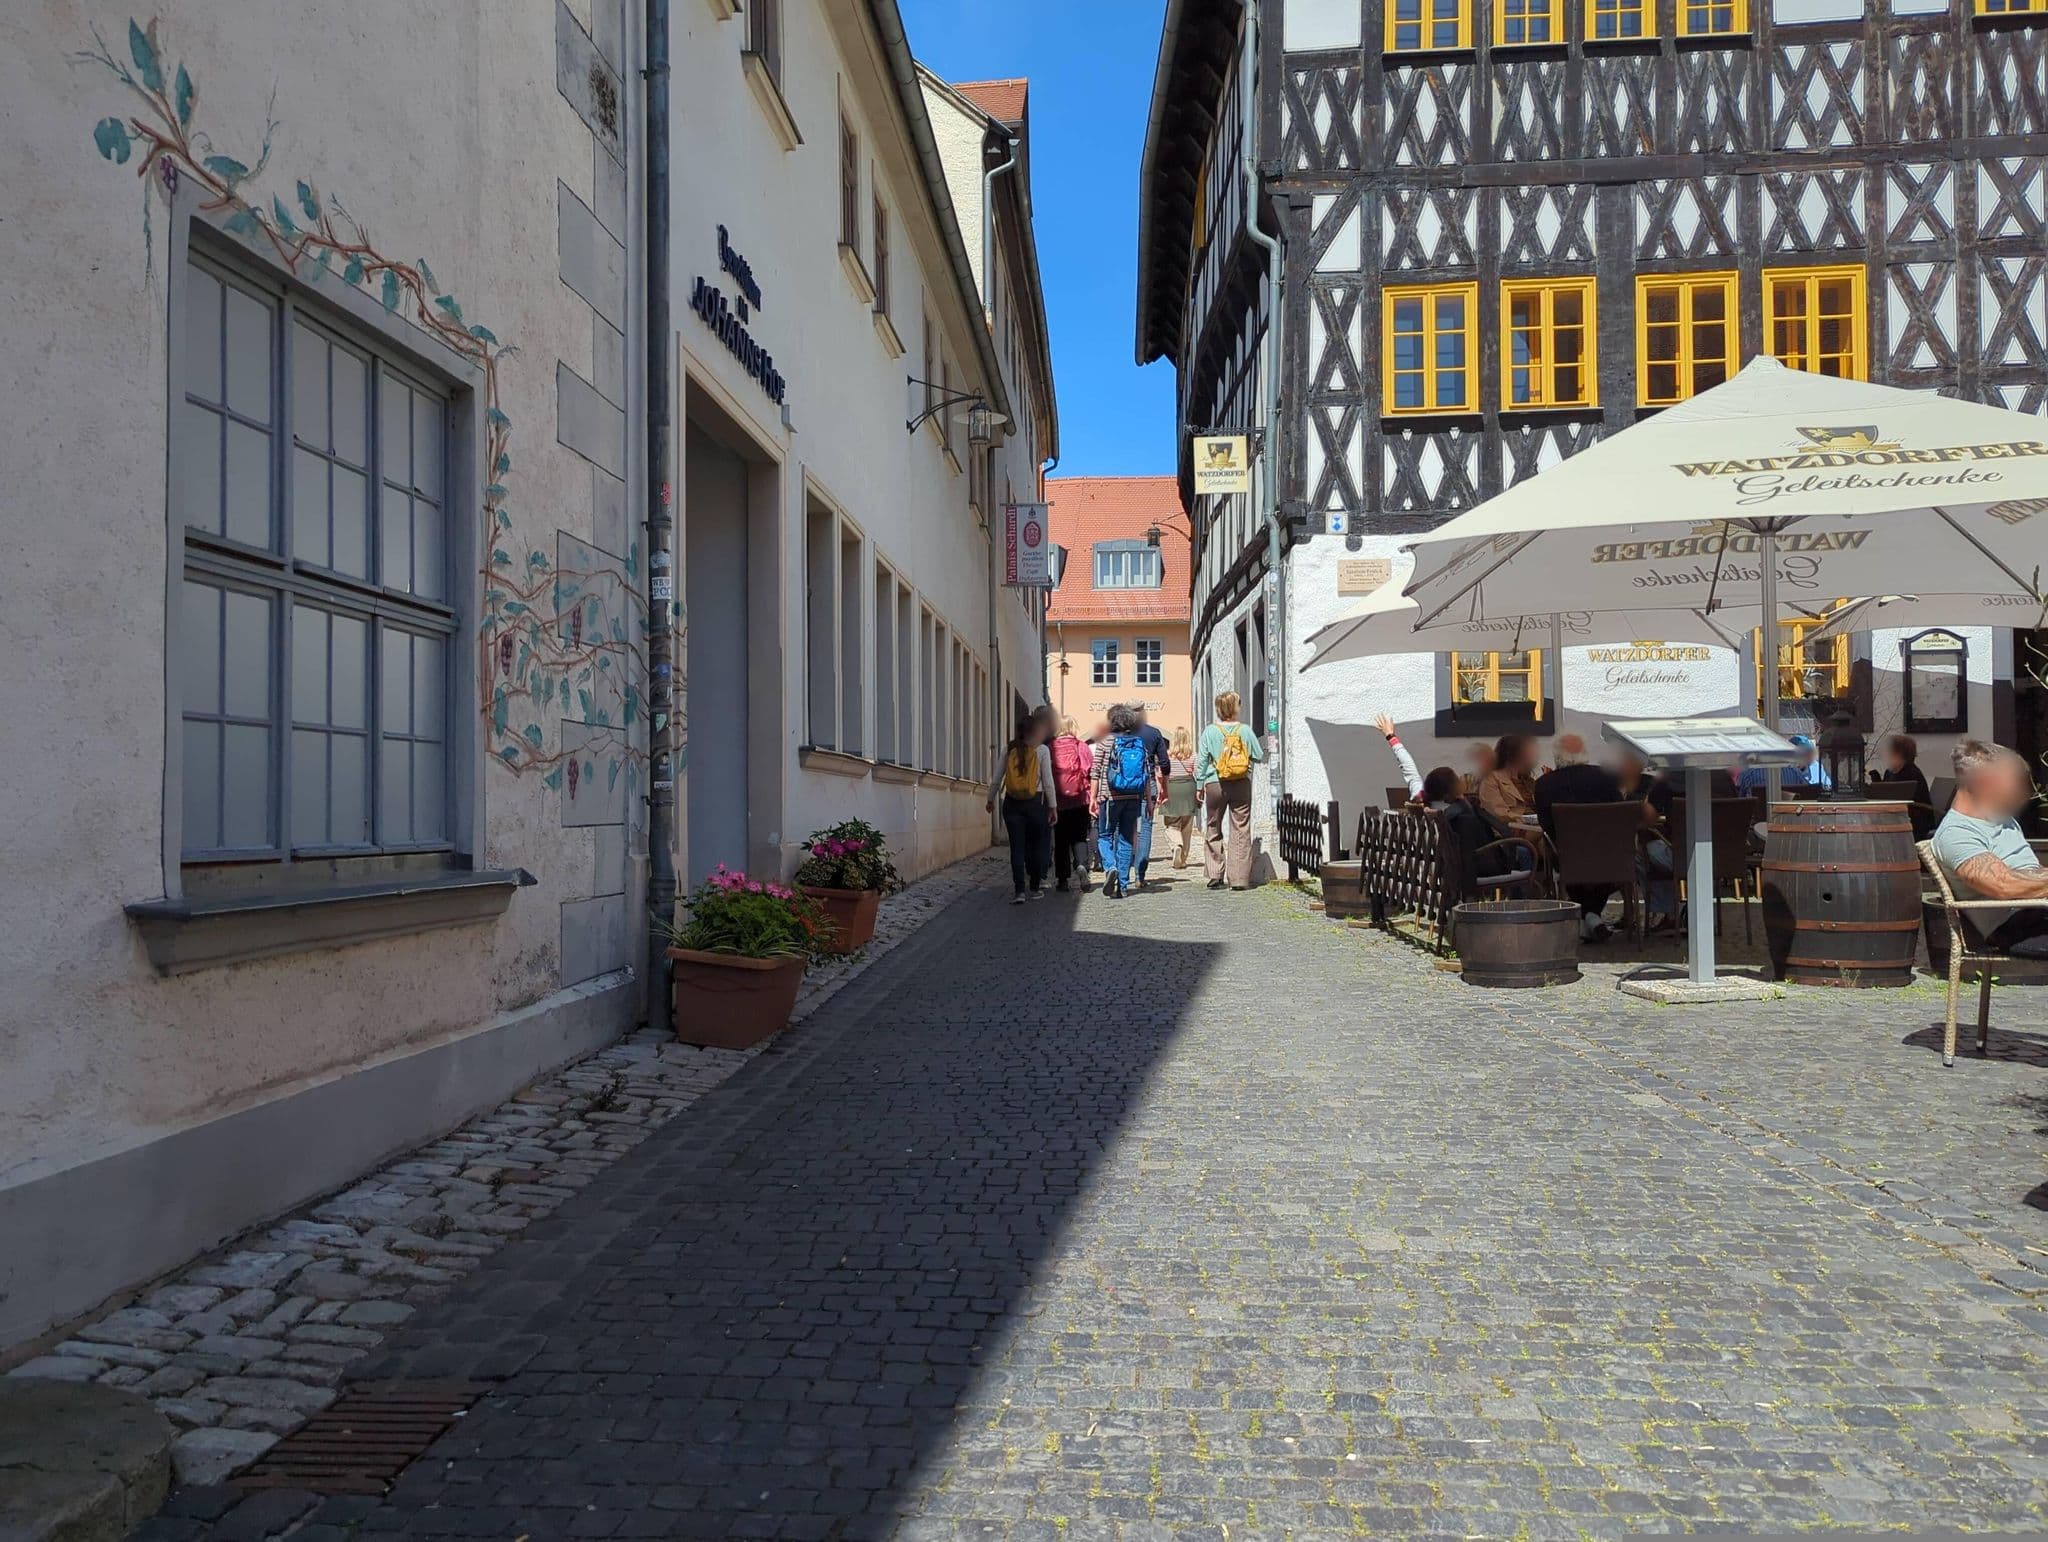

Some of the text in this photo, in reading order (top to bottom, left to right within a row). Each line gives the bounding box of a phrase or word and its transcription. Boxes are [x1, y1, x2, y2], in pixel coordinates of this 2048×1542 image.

[1670, 440, 2047, 478] WATZDORFER
[1732, 467, 2004, 506] Geleitschenke
[1007, 508, 1017, 582] Palais Schardt
[1587, 647, 1711, 663] WATZDORFER
[1088, 701, 1167, 713] STAHIV
